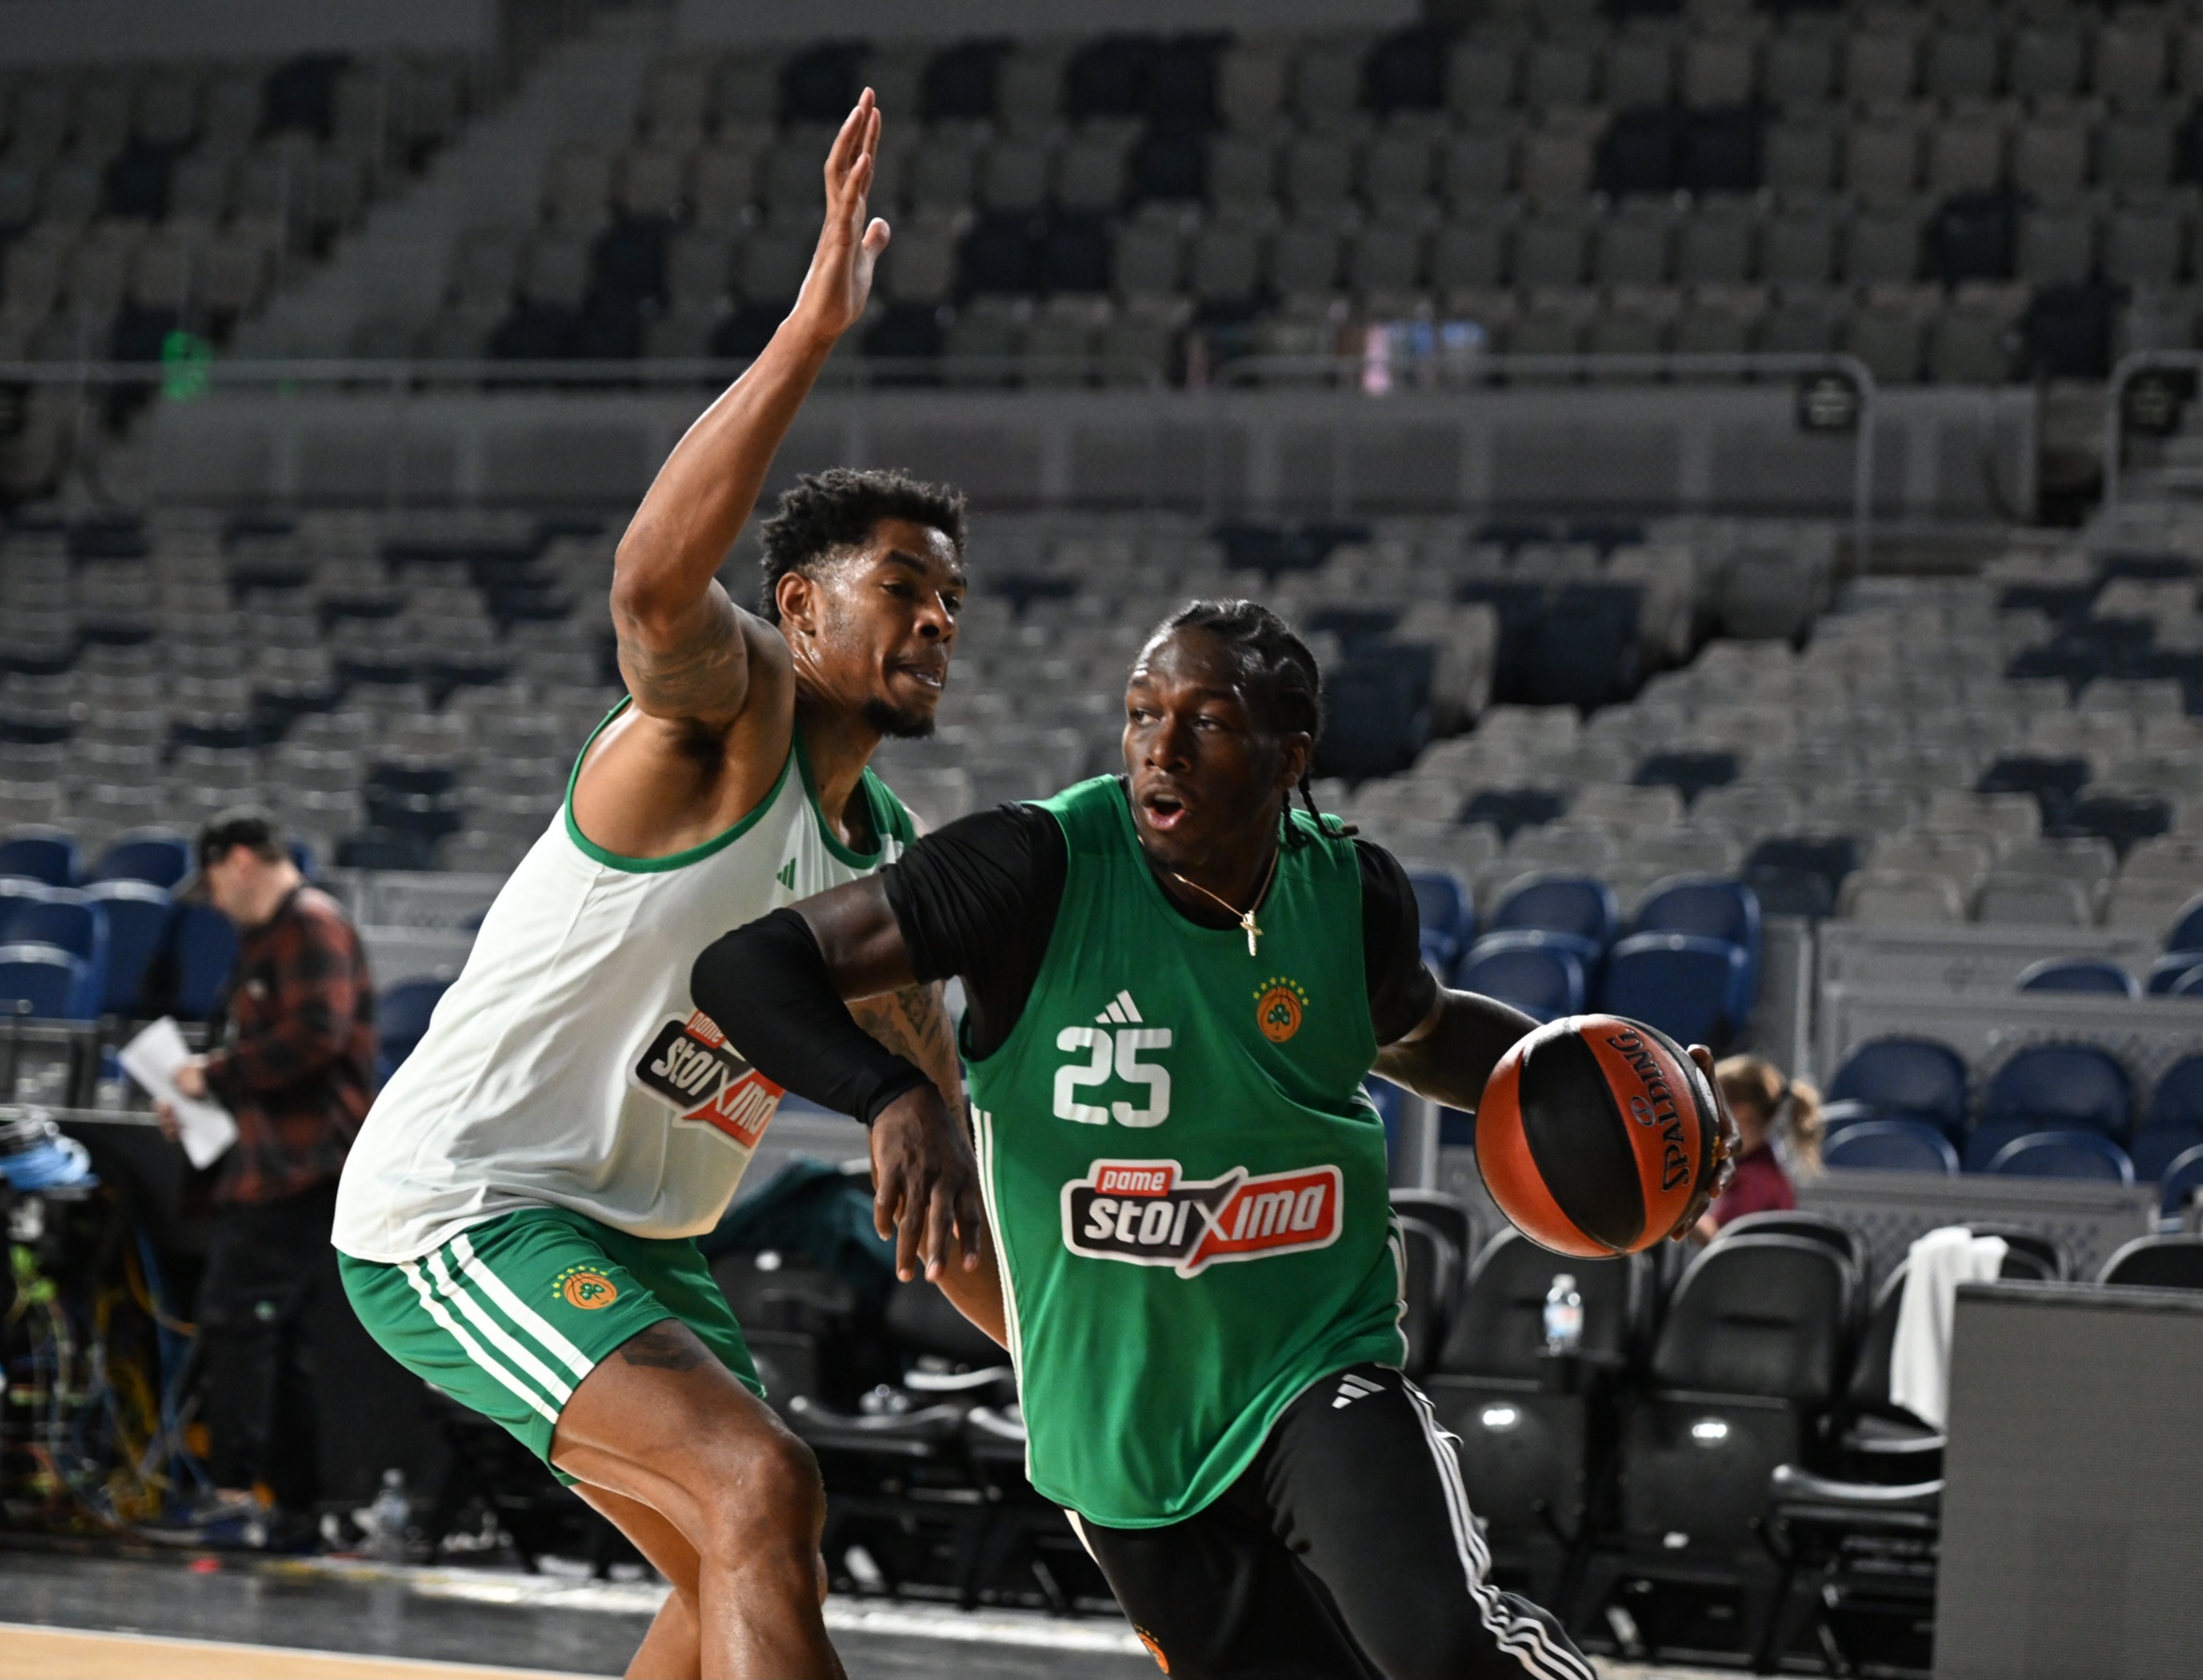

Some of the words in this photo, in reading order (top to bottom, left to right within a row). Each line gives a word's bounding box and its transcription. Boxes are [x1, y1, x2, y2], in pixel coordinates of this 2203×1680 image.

[1053, 1026, 1172, 1127] 25
[1605, 1028, 1690, 1192] SPALDING
[1102, 1170, 1166, 1193] pame
